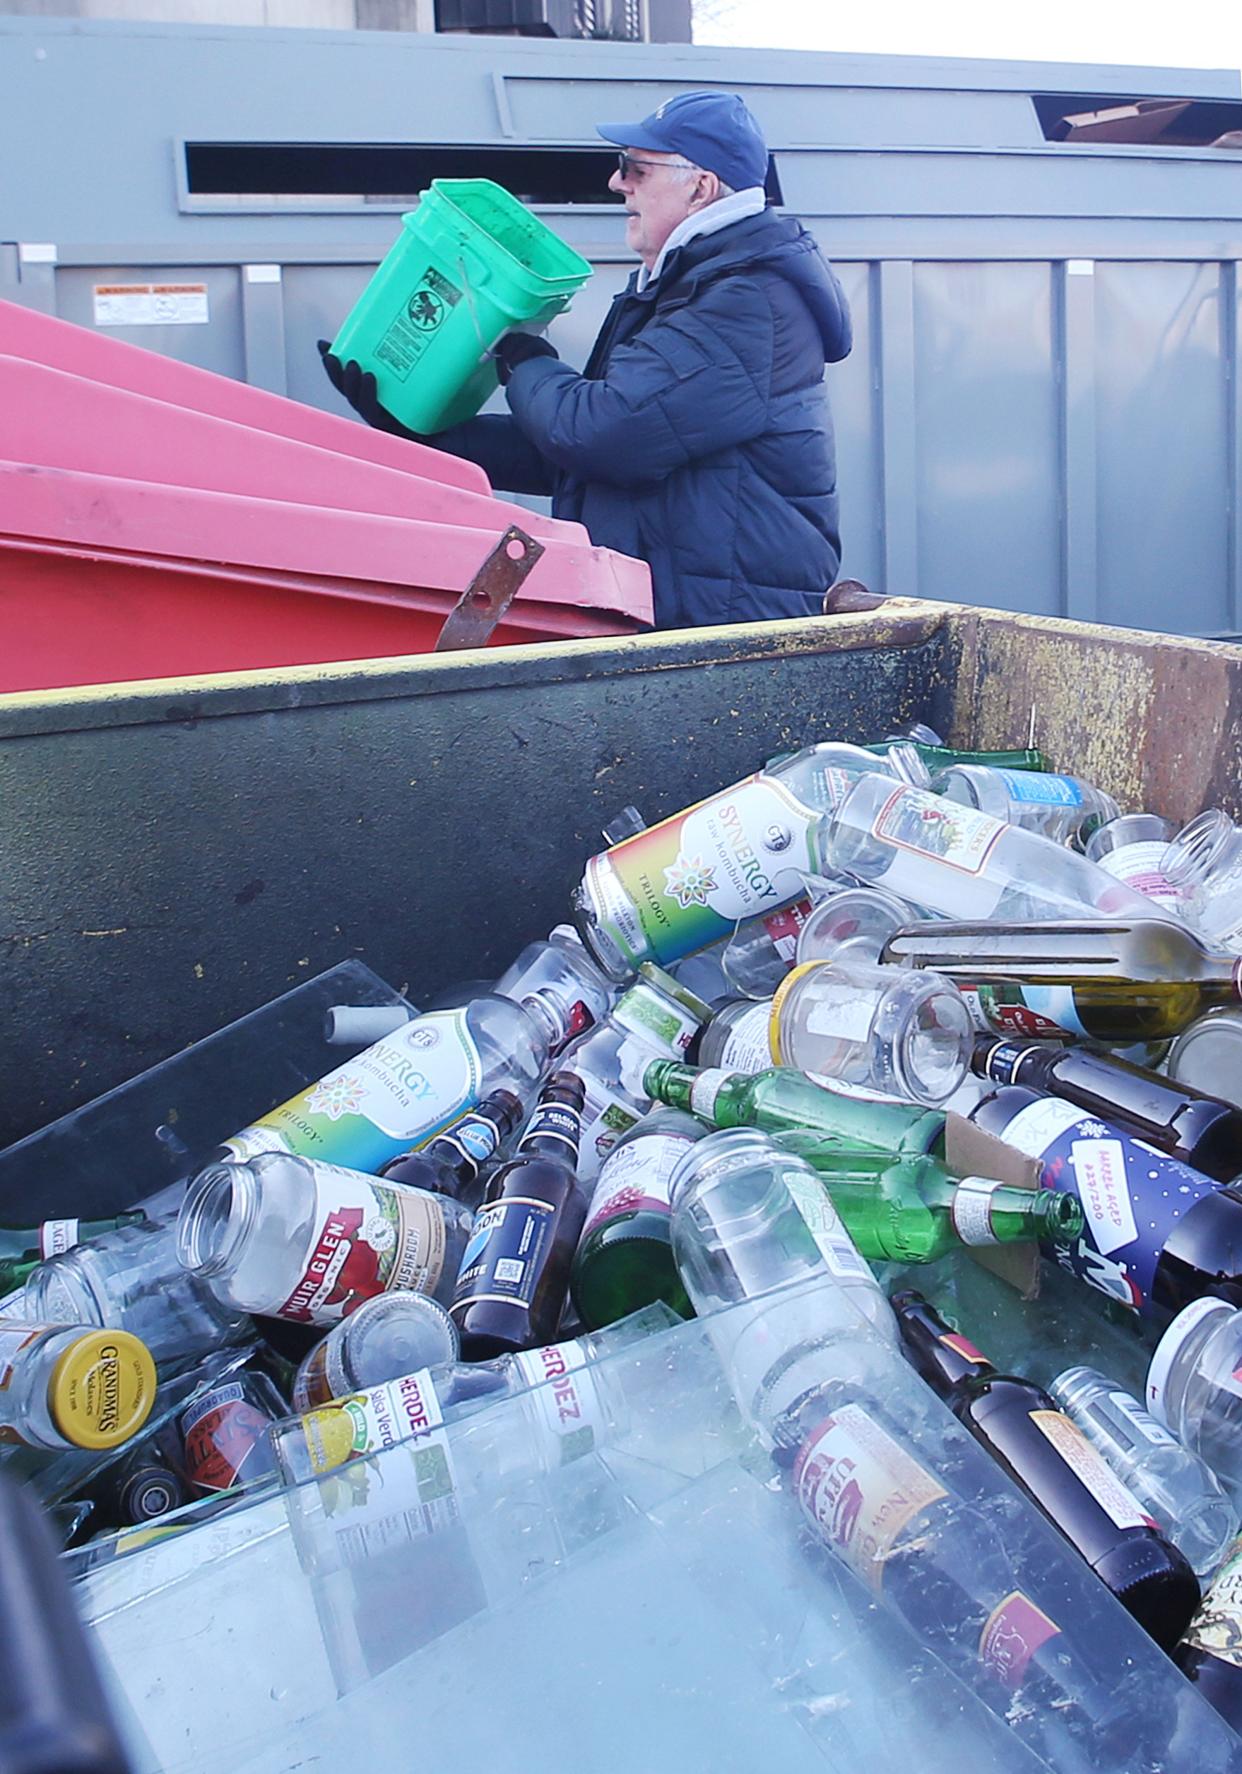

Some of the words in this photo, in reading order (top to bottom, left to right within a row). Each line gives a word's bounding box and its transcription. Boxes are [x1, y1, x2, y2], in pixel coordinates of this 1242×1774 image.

[716, 842, 751, 904] kombucha
[718, 804, 777, 900] SYNERGY
[639, 874, 668, 926] TRILOGY
[359, 1061, 409, 1107] kombucha
[278, 1109, 320, 1143] TRILOGY
[51, 1222, 66, 1255] LAGE
[286, 1278, 320, 1315] MUIR
[310, 1221, 345, 1274] GLEN
[392, 1229, 419, 1292] MUSHROOM
[311, 1246, 347, 1309] ORGANIC
[87, 1371, 95, 1415] Molasses
[98, 1345, 119, 1432] GRANDMA'S
[370, 1389, 386, 1414] Salsa
[379, 1413, 396, 1448] Verd
